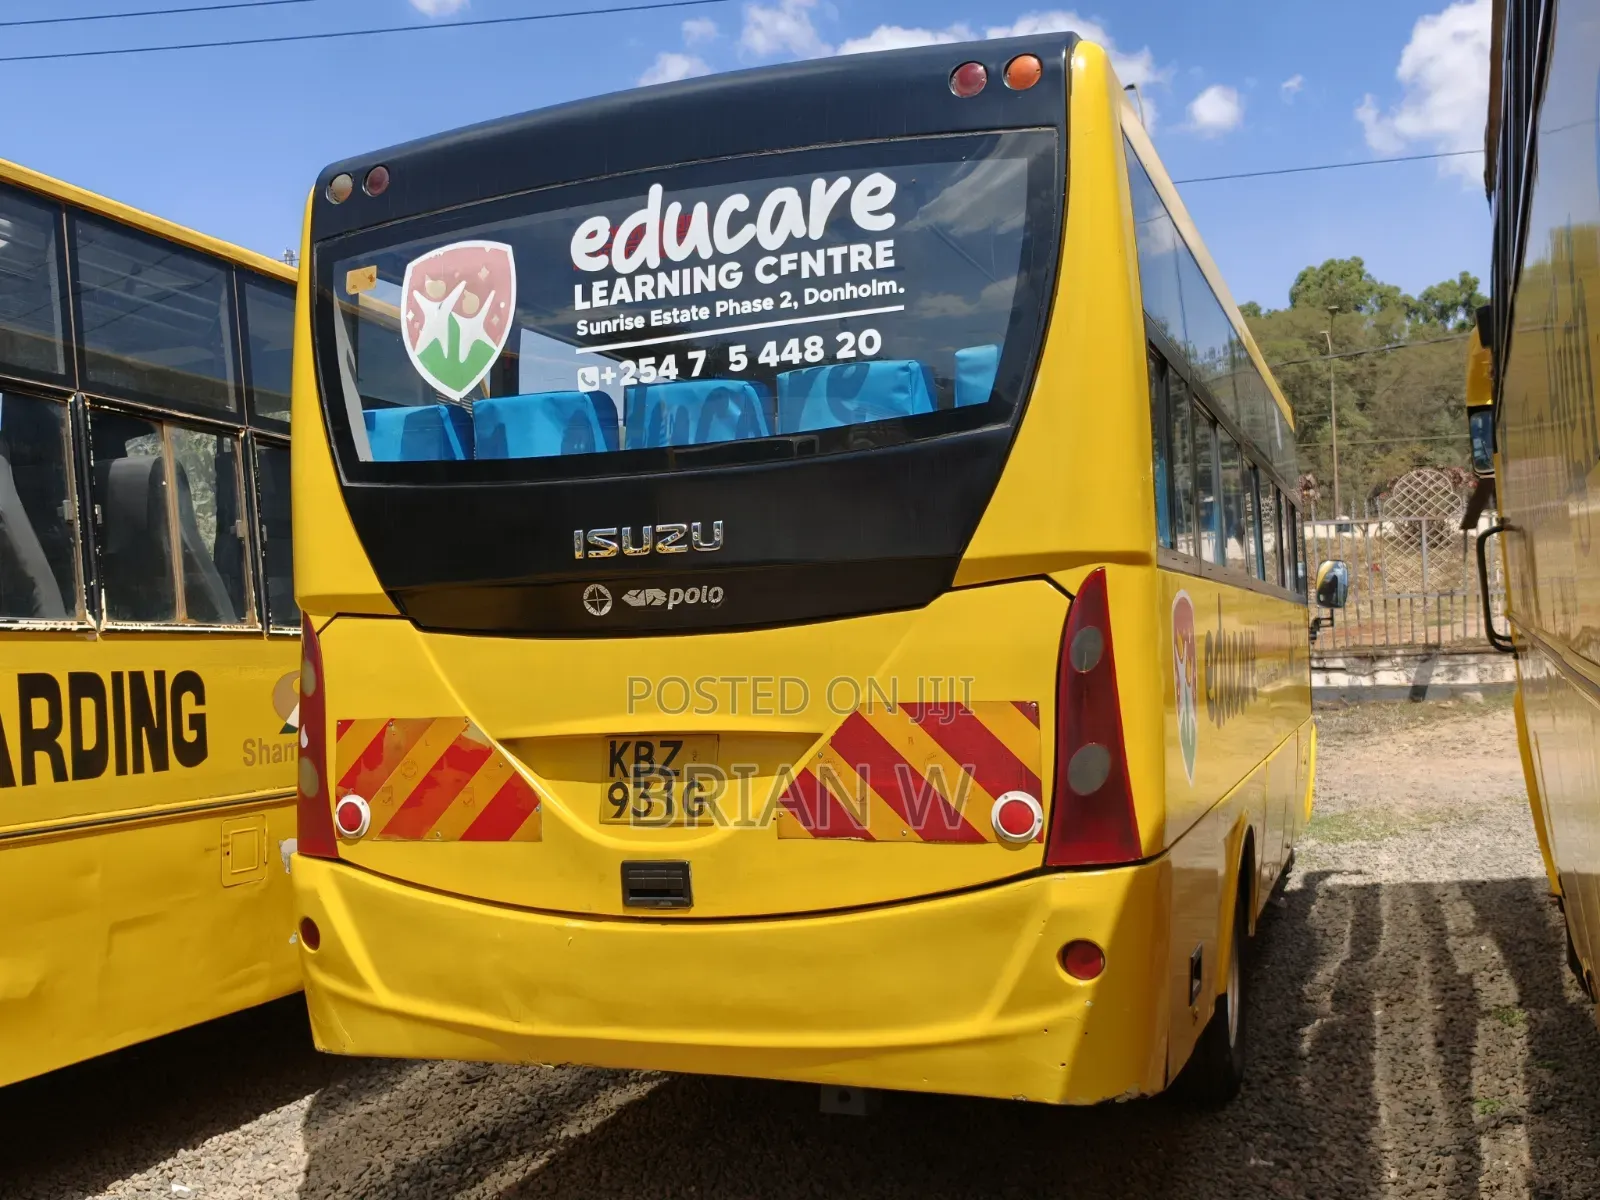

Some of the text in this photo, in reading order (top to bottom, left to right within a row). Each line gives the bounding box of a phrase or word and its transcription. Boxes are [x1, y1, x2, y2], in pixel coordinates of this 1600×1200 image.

[570, 172, 897, 275] educare
[573, 261, 744, 311] LEARNING
[576, 279, 905, 336] Sunrise Estate Phase 2, Donholm.
[728, 345, 748, 372] 5
[757, 335, 824, 367] 448
[835, 327, 882, 359] 20
[573, 519, 723, 560] ISUZU
[0, 670, 208, 789] RDING
[609, 740, 684, 778] KBZ
